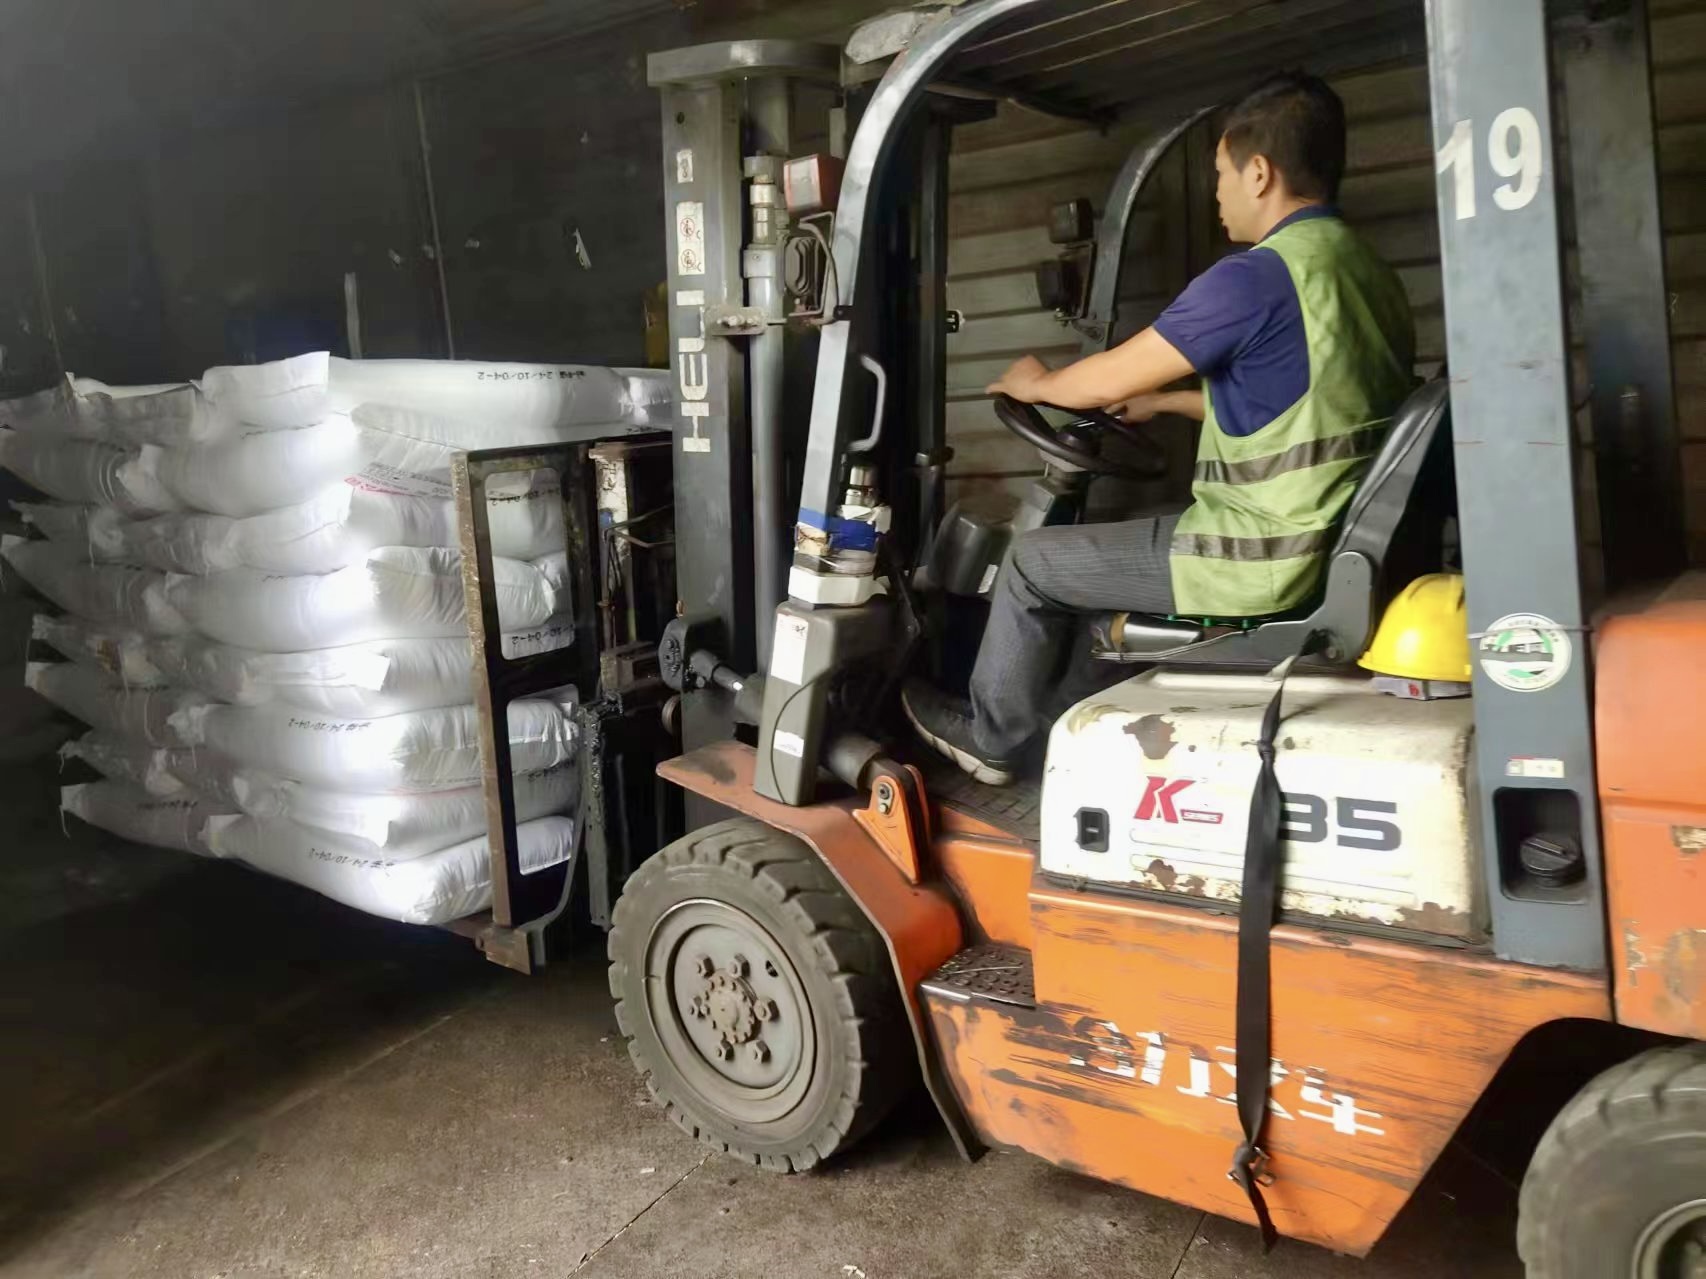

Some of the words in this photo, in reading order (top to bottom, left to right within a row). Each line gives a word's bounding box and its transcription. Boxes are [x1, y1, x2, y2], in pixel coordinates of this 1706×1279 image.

[1436, 107, 1542, 220] 19
[676, 290, 711, 452] HELI
[1133, 775, 1195, 824] K
